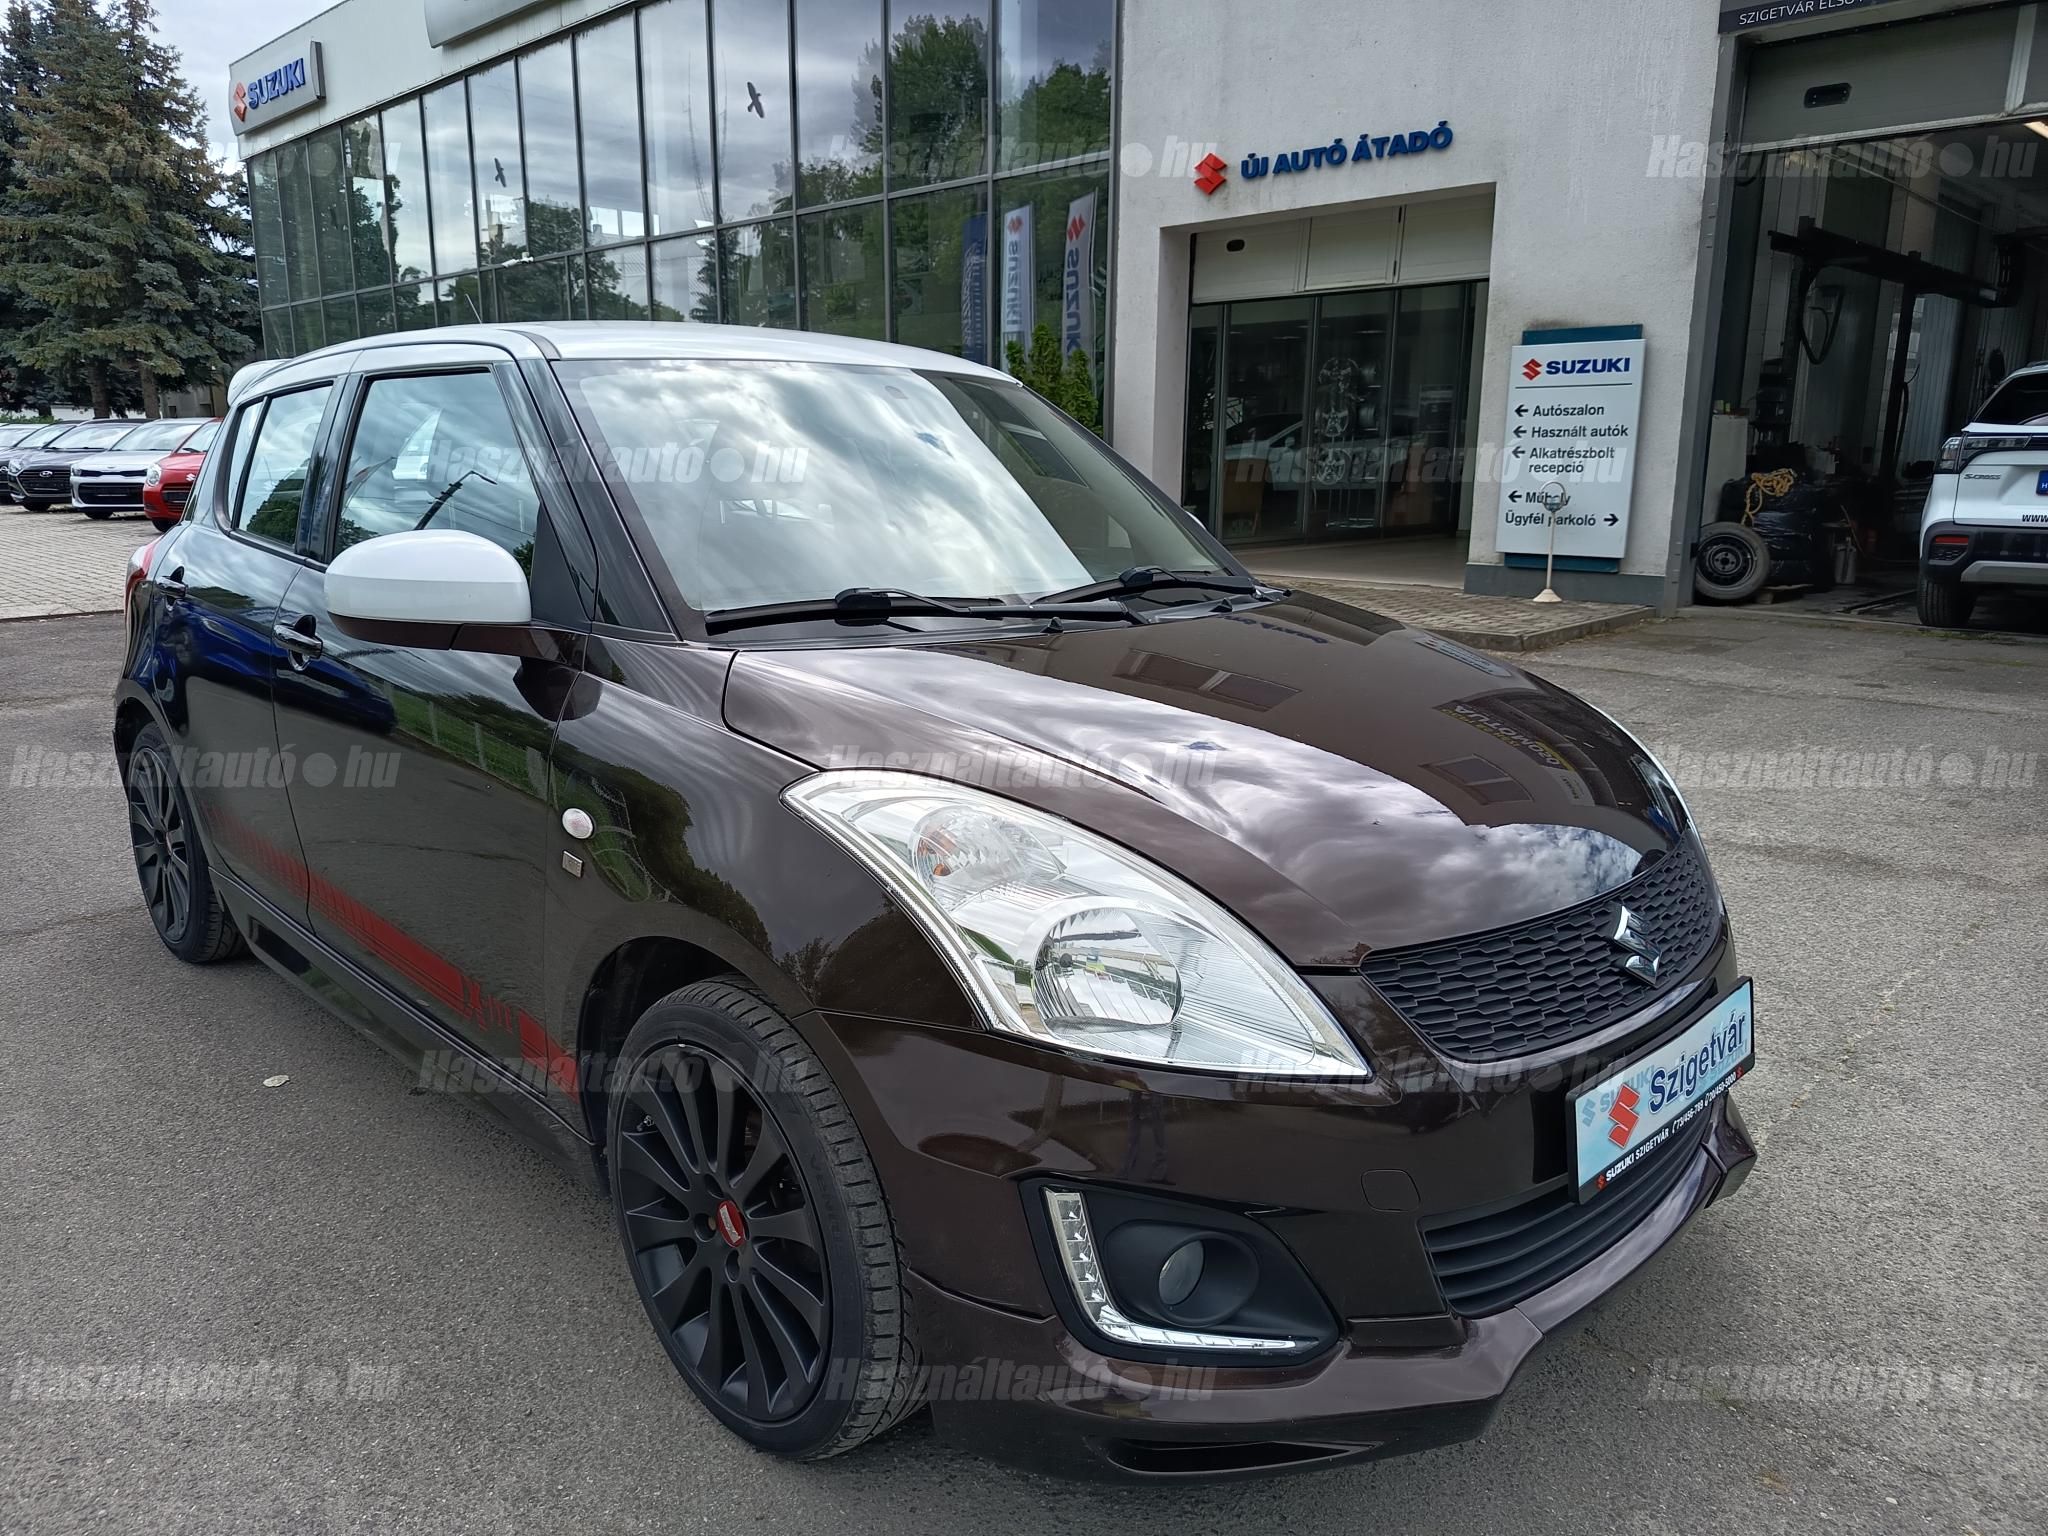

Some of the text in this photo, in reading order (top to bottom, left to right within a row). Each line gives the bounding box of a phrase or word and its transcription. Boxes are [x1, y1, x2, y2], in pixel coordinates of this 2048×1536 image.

[1739, 0, 1814, 25] SZIGETVÁR
[247, 57, 306, 110] SUZUKI
[1241, 120, 1454, 179] ÚJ AUTÓ ÁTADÓ
[1545, 357, 1630, 375] SUZUKI
[1532, 403, 1605, 417] Autószalon
[1531, 424, 1629, 438] Használt autók
[1529, 446, 1615, 459] Alkatrészbolt
[1528, 460, 1584, 475] recepció
[1505, 510, 1545, 526] Ügyfél
[1649, 1012, 1746, 1113] Szigetvár
[1606, 1152, 1634, 1181] SUZUKI
[1635, 1127, 1669, 1160] SZIGETVÁR
